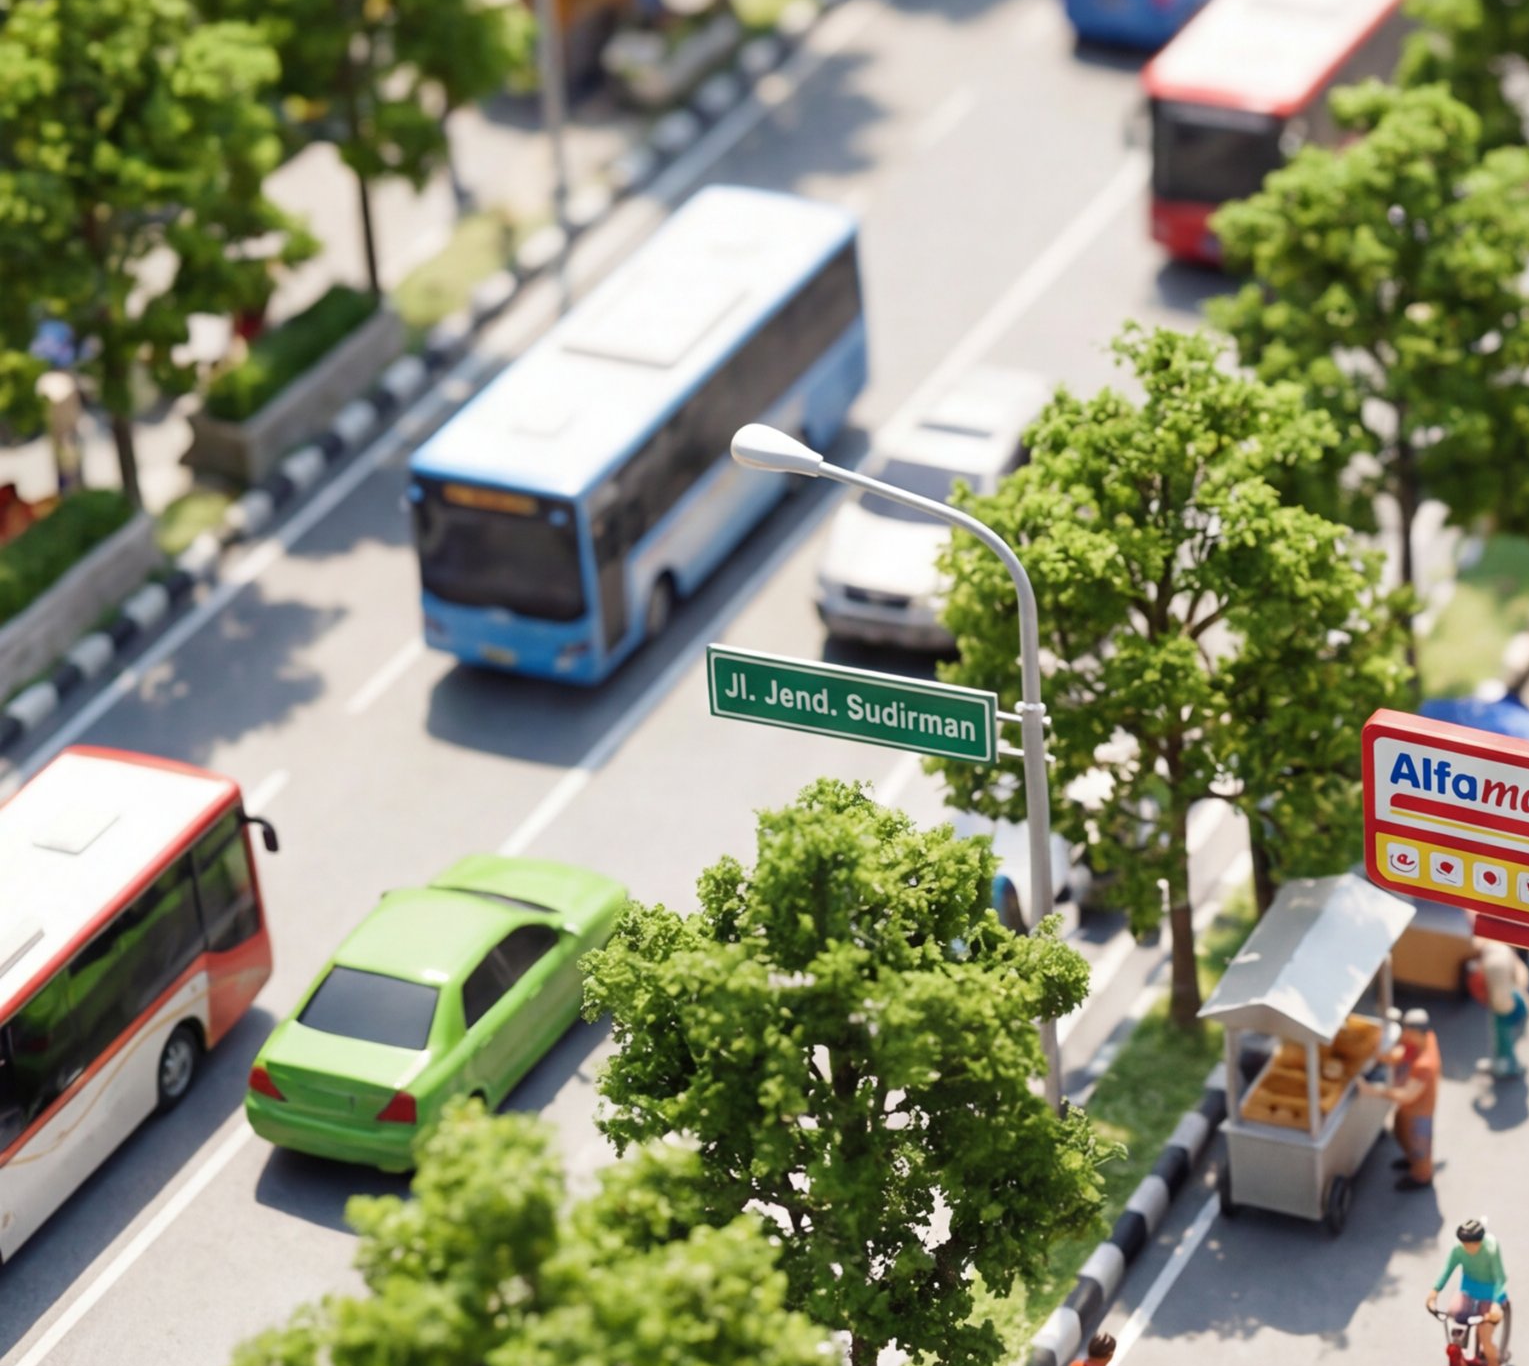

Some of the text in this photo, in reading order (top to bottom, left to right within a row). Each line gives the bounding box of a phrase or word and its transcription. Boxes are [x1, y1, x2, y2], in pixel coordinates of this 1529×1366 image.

[725, 672, 977, 742] Jl. Jend. Sudirman
